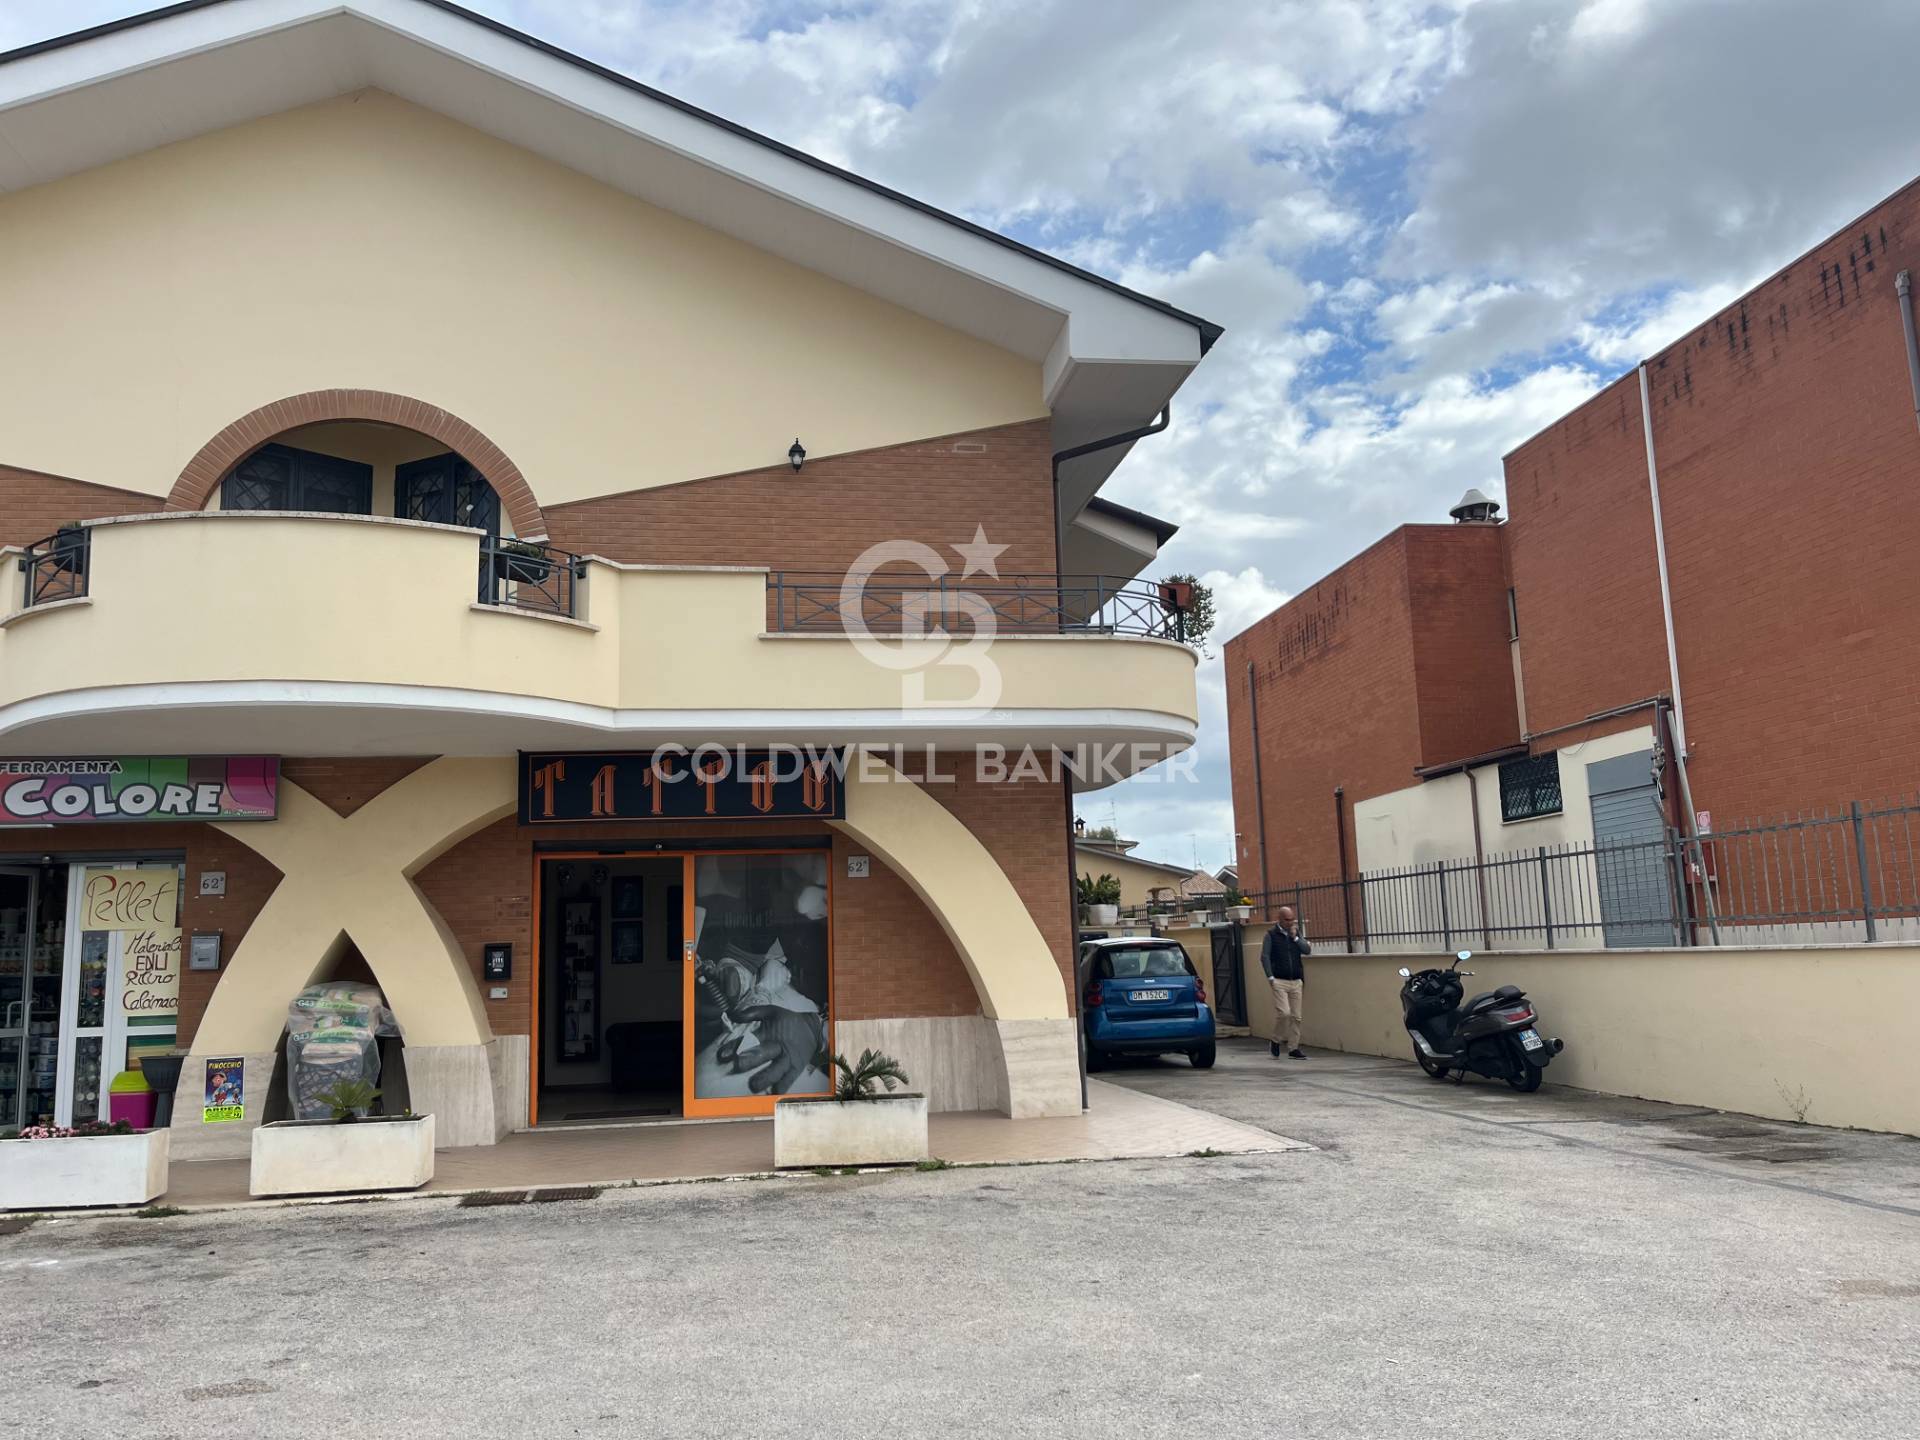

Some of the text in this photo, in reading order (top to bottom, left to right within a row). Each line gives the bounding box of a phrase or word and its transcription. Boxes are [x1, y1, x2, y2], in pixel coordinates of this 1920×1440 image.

[0, 761, 122, 774] FERRAMENTA
[4, 779, 223, 816] COLORE
[533, 758, 830, 817] TATTOO
[86, 874, 175, 926] Pellet
[208, 1061, 242, 1069] PINOCCHIO
